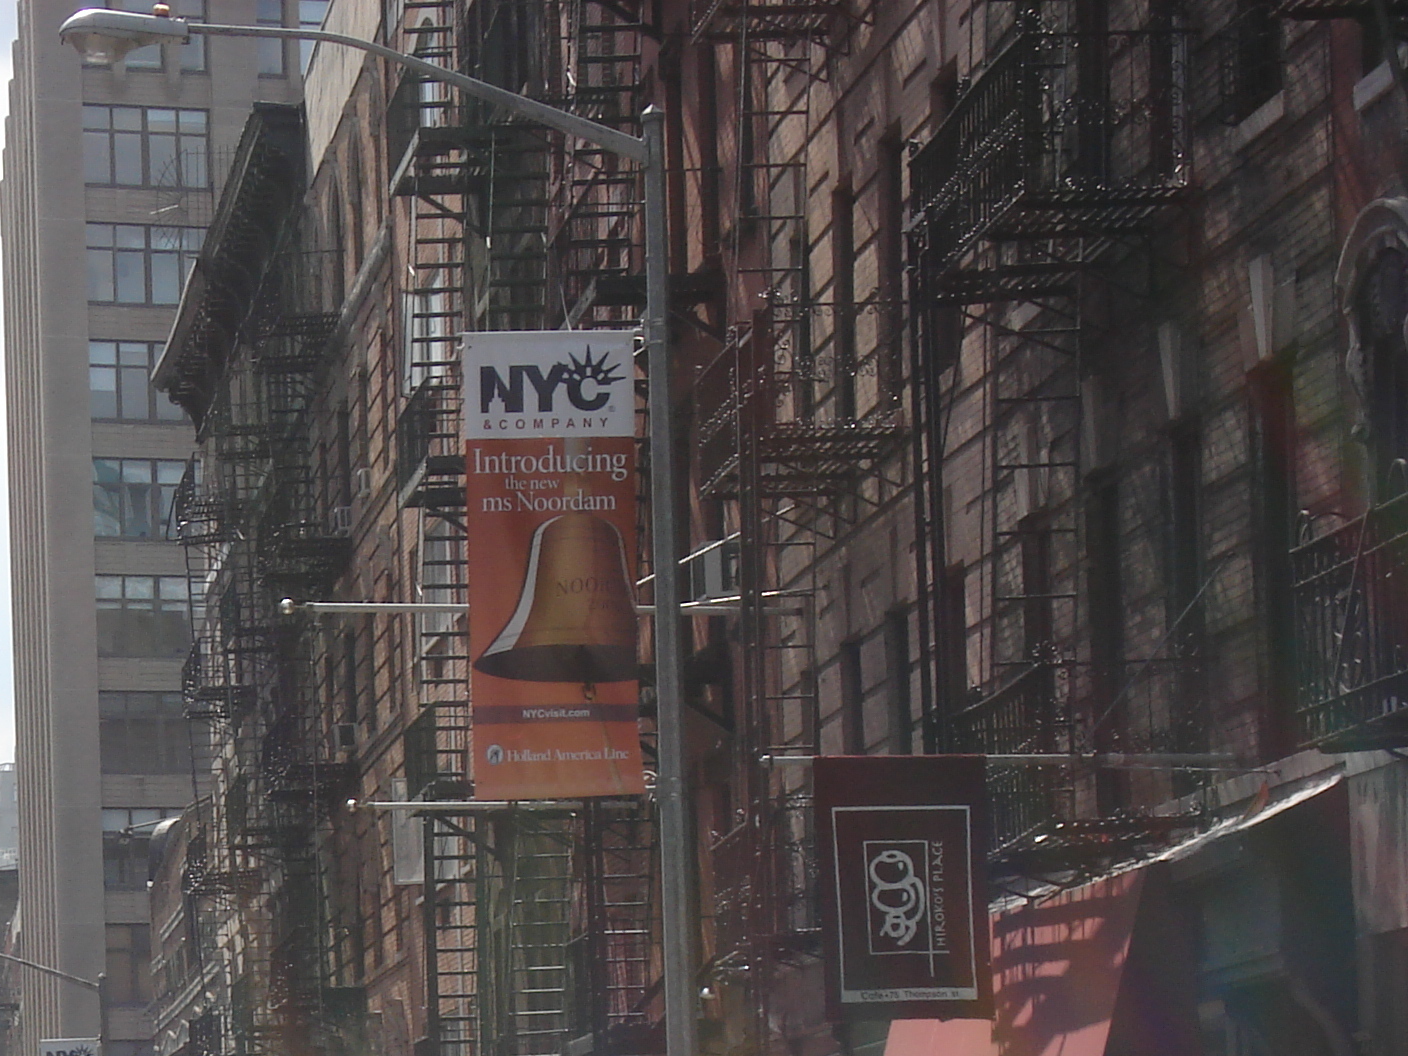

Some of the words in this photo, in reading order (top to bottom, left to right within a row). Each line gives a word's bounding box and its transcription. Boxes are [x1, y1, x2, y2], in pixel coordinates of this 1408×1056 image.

[480, 350, 620, 413] NYC
[473, 445, 628, 482] Introducing
[505, 475, 527, 490] the
[530, 477, 560, 490] new
[481, 497, 513, 512] ms
[516, 489, 617, 512] Noordam
[522, 708, 591, 719] NYCvisit.com
[507, 749, 551, 762] Holland
[553, 748, 602, 761] America
[604, 748, 629, 760] Line
[932, 840, 944, 882] PLACE
